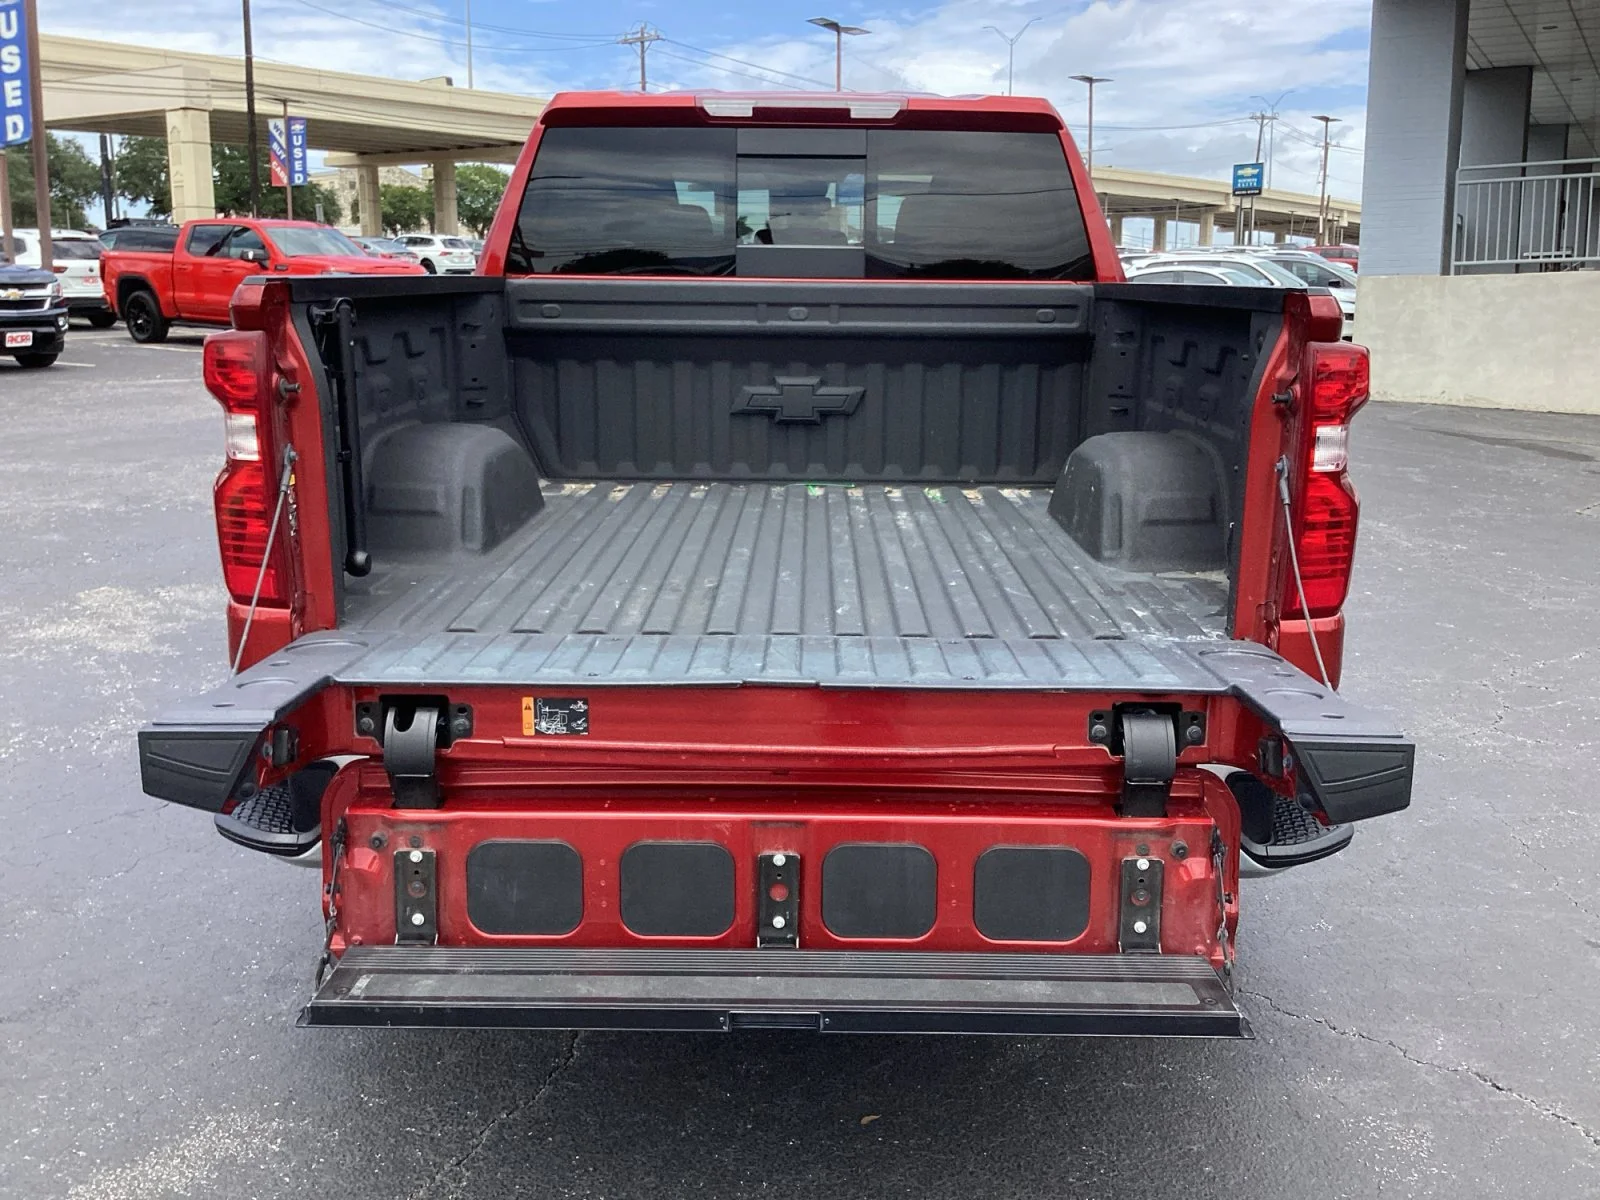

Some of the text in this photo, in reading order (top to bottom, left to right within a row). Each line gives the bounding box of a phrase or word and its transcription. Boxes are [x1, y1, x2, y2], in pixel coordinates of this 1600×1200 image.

[0, 9, 24, 141] USED
[273, 122, 285, 138] WE
[271, 142, 286, 160] BUY
[292, 135, 304, 184] USED
